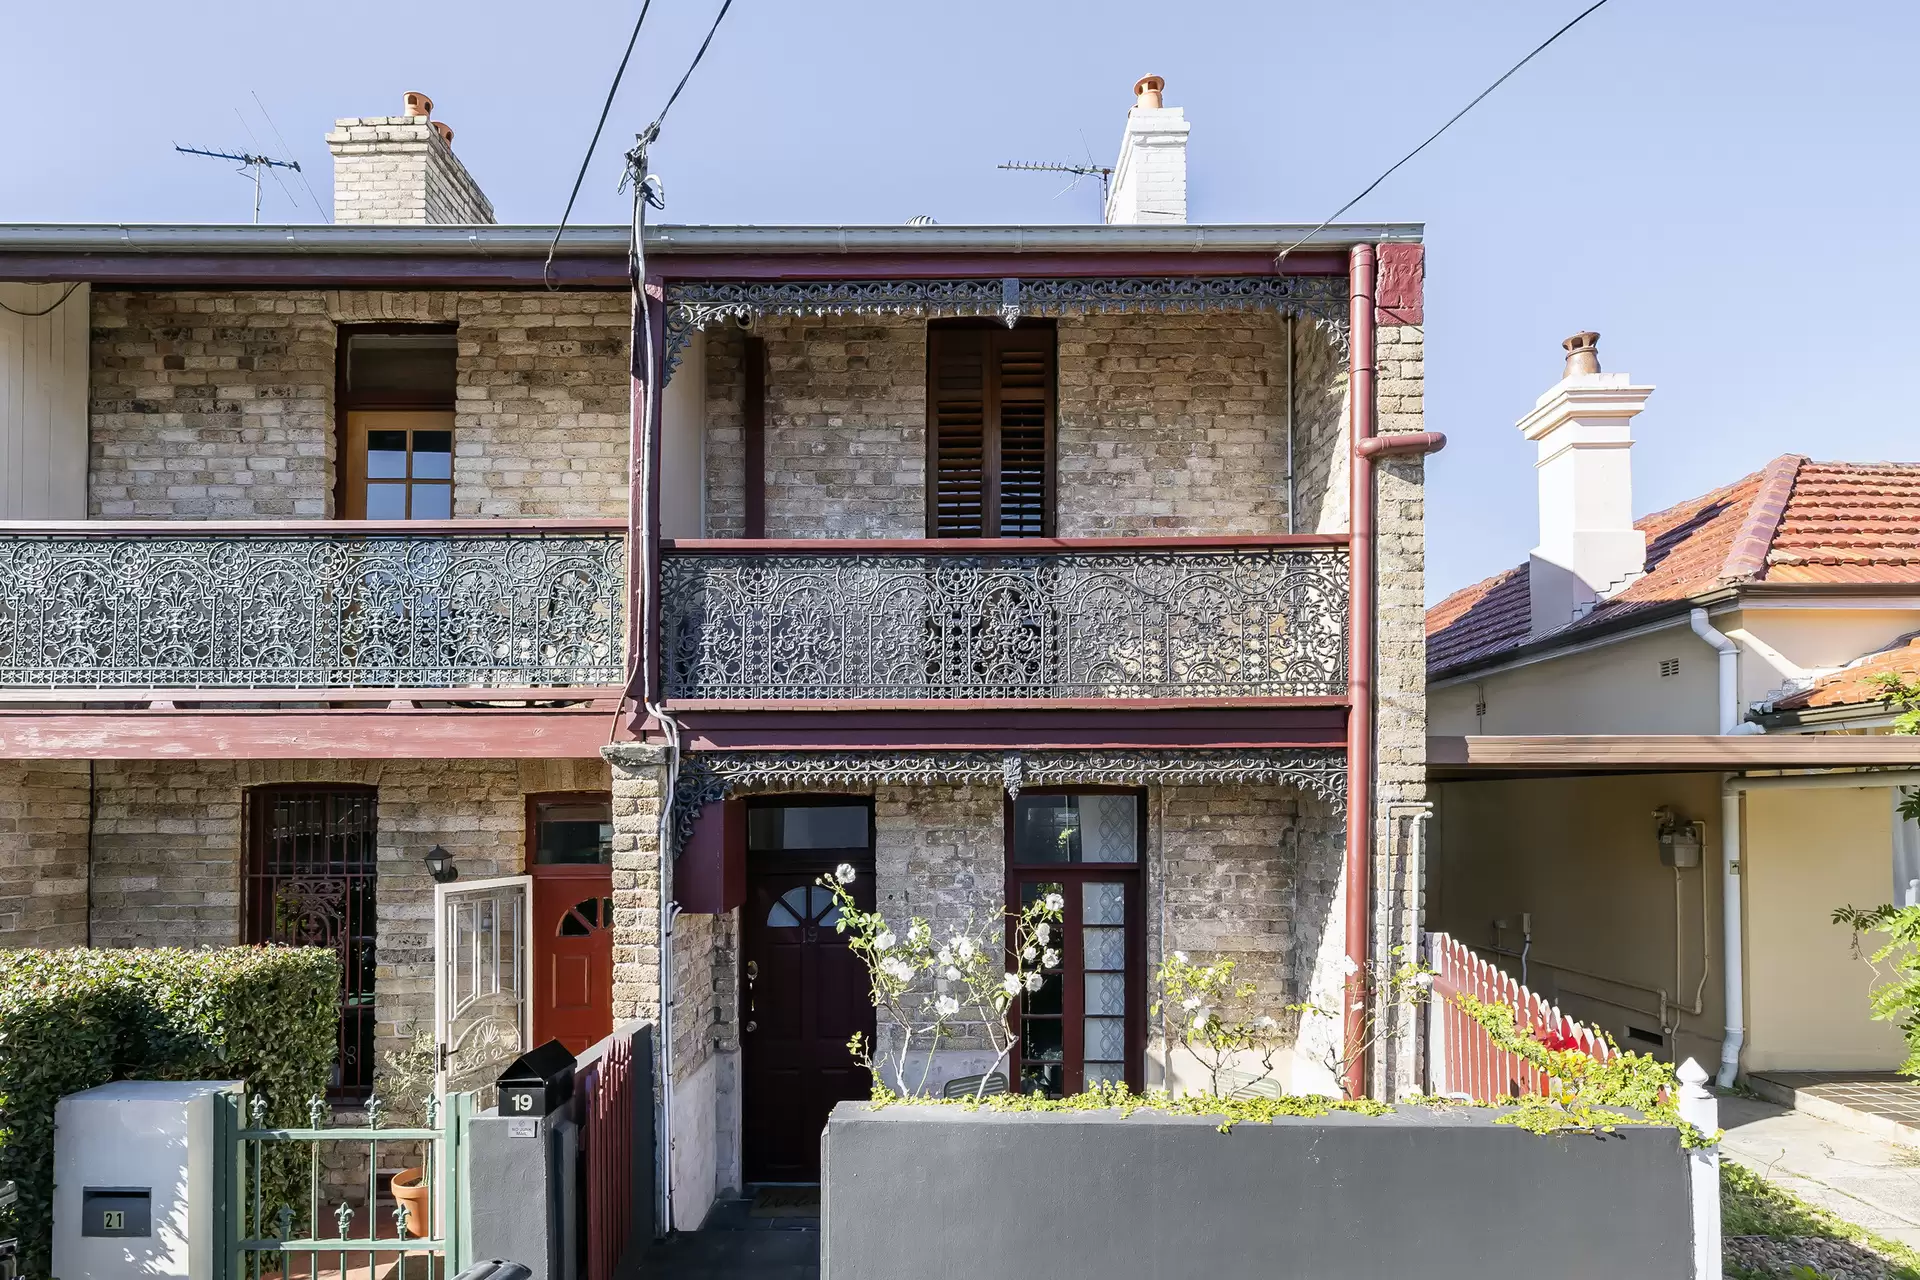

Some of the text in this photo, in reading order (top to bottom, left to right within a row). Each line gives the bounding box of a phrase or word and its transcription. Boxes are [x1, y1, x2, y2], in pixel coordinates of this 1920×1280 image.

[801, 926, 818, 943] 19
[511, 1094, 533, 1111] 19
[105, 1213, 122, 1228] 21
